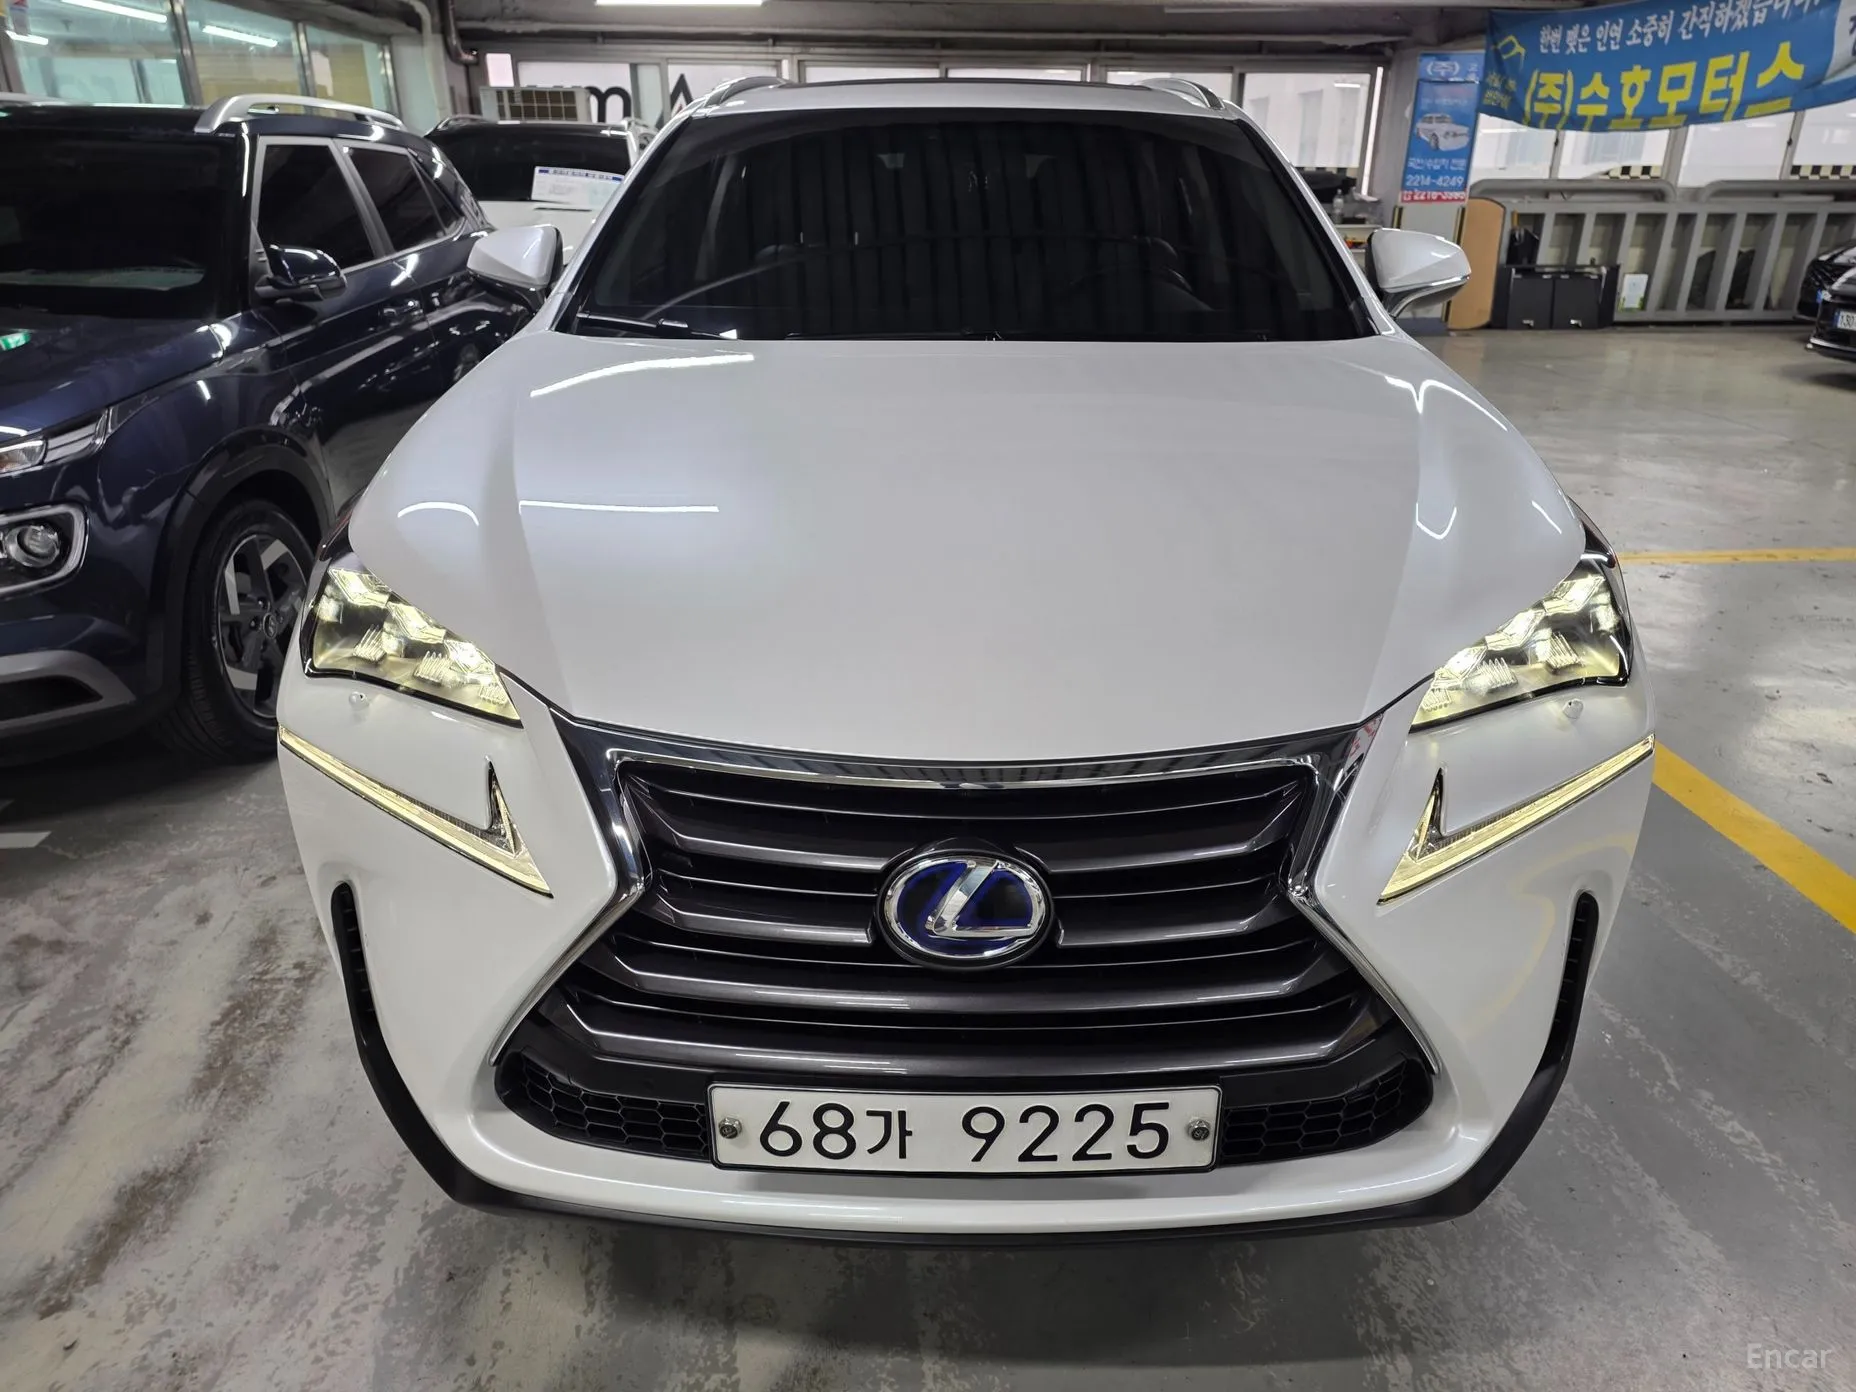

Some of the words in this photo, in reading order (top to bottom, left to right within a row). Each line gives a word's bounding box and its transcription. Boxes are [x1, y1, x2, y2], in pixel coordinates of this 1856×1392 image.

[1596, 18, 1624, 52] 인연
[1625, 10, 1675, 46] 소중히
[759, 1100, 913, 1161] 68가
[961, 1102, 1170, 1163] 9225
